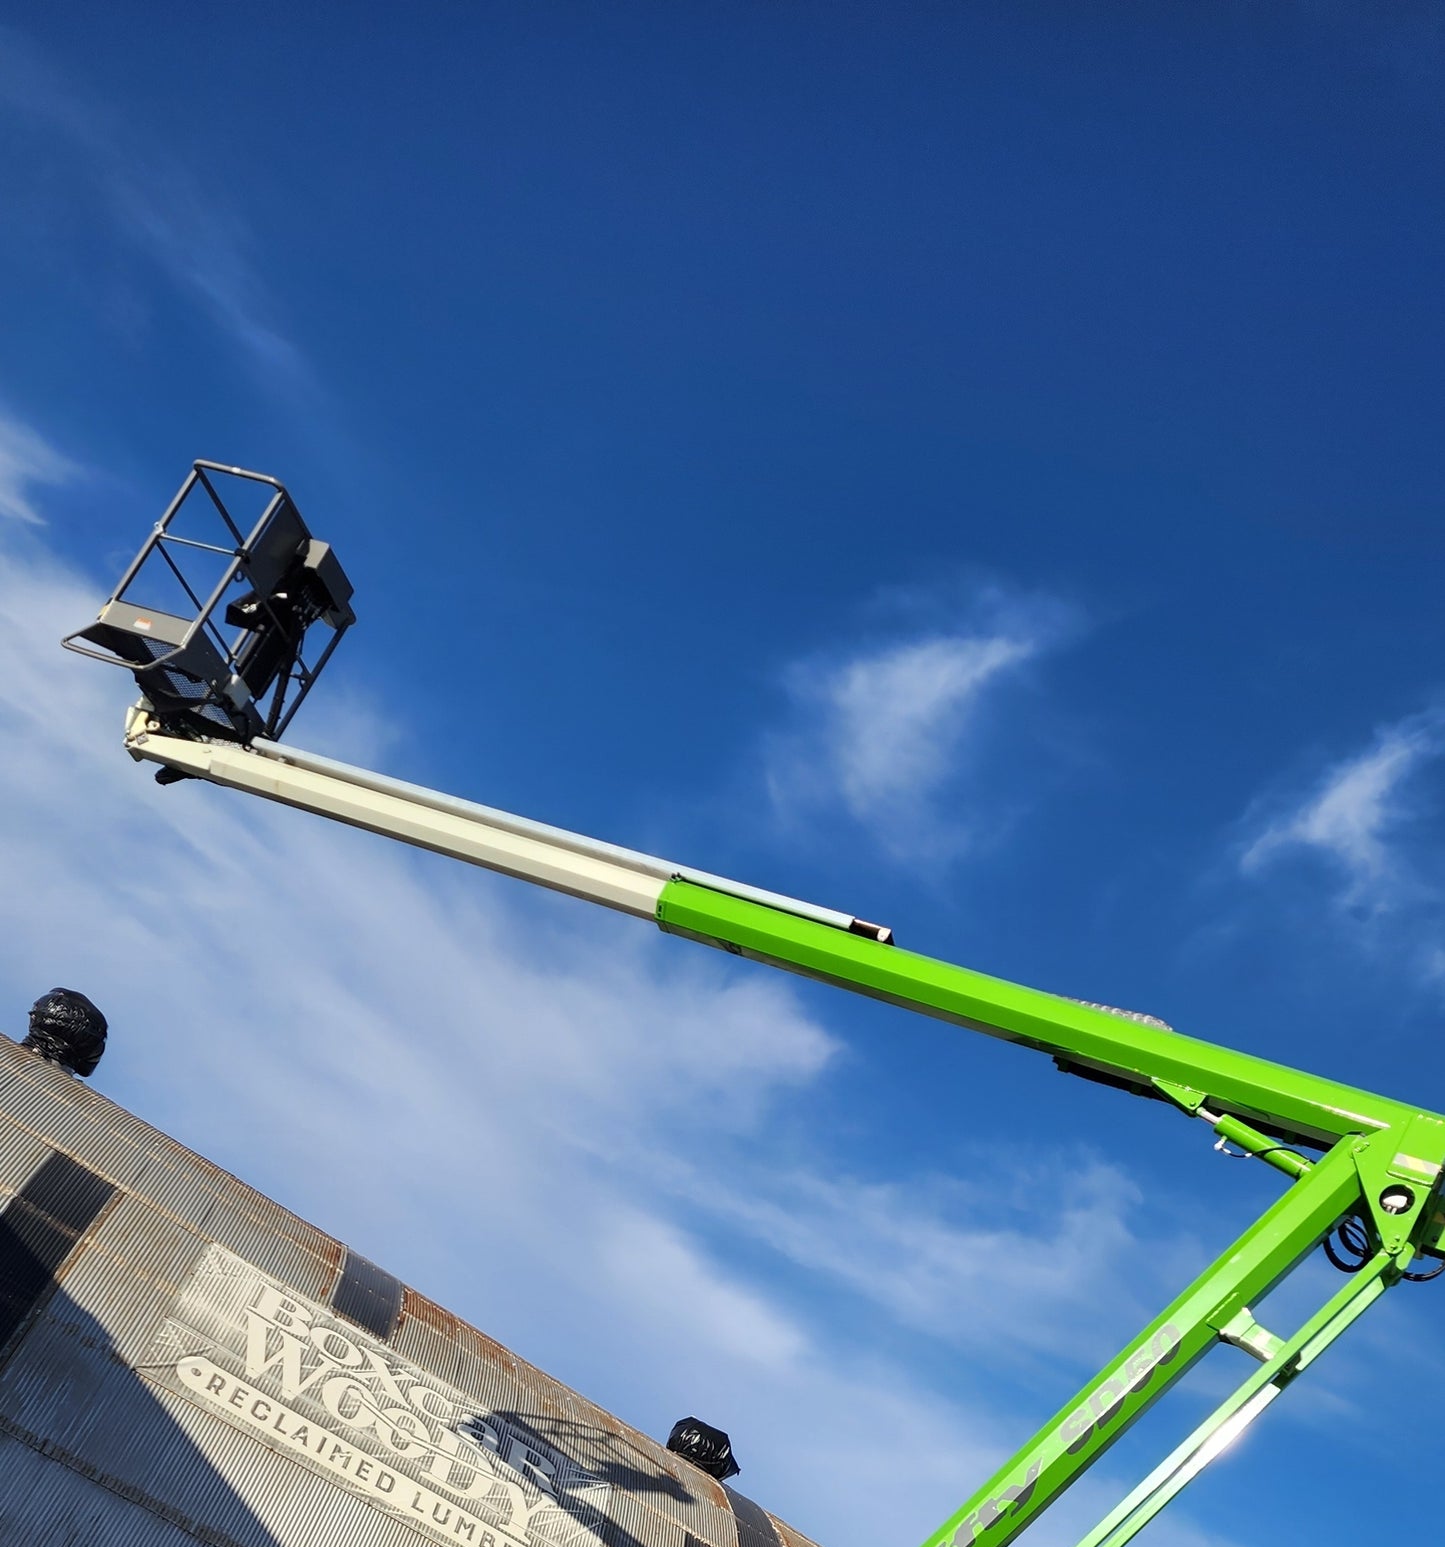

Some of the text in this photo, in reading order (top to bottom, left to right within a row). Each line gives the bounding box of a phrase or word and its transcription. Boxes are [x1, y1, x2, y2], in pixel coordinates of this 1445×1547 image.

[206, 1371, 397, 1493] RECLAIMED
[244, 1311, 558, 1544] WOODY
[1060, 1322, 1181, 1455] SD50
